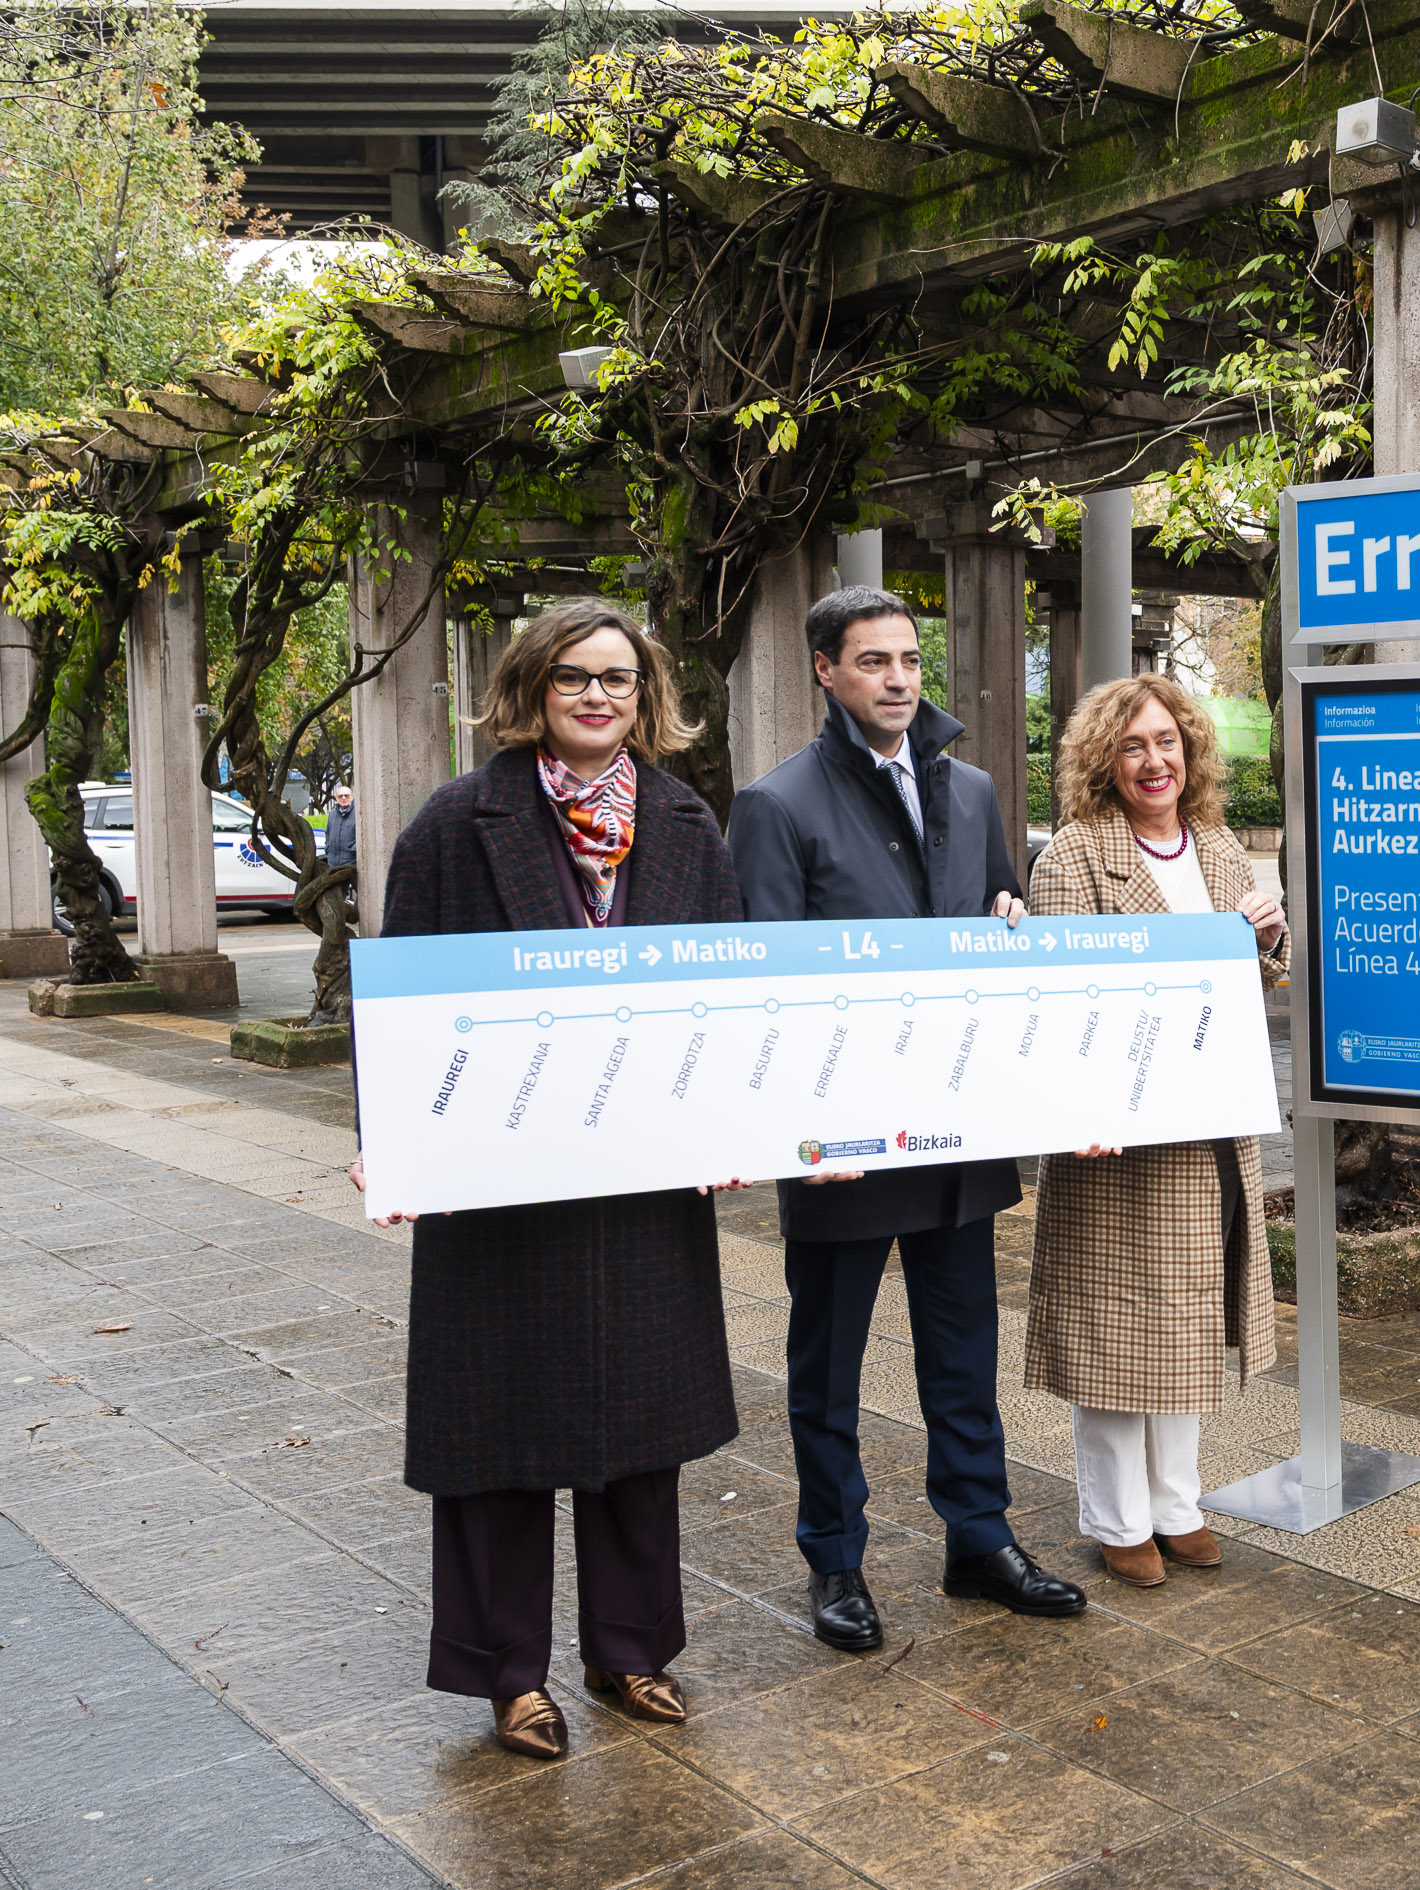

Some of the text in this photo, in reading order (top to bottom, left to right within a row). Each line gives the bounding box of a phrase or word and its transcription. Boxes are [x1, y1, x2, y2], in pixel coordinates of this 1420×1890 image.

[1325, 705, 1375, 715] Informazioa
[1325, 718, 1374, 727] Información
[1332, 767, 1353, 790] 4.
[514, 942, 627, 973] Irauregi
[672, 937, 766, 963] Matiko
[842, 932, 880, 959] L4
[950, 928, 1030, 952] Matiko
[1065, 926, 1149, 953] Irauregi
[1336, 947, 1420, 975] Línea 4
[895, 1021, 914, 1055] IRALA
[1019, 1015, 1039, 1056] MOYUA
[1079, 1012, 1099, 1056] PARKEA
[1128, 1009, 1149, 1062] DEUSTU/
[1193, 1006, 1211, 1050] MATIKO
[1367, 1038, 1386, 1046] EUSKO
[672, 1033, 706, 1099] ZORROTZA
[749, 1029, 779, 1089] BASURTU
[814, 1025, 847, 1097] ERREKALDE
[948, 1018, 978, 1091] ZABALBURU
[1128, 1016, 1162, 1112] UNIBERTSITATEA
[1368, 1050, 1400, 1059] GOBIERNO
[432, 1049, 468, 1115] IRAUREGI
[506, 1043, 551, 1129] KASTREXANA
[584, 1037, 630, 1127] SANTA AGEDA
[908, 1135, 961, 1151] Bizkaia
